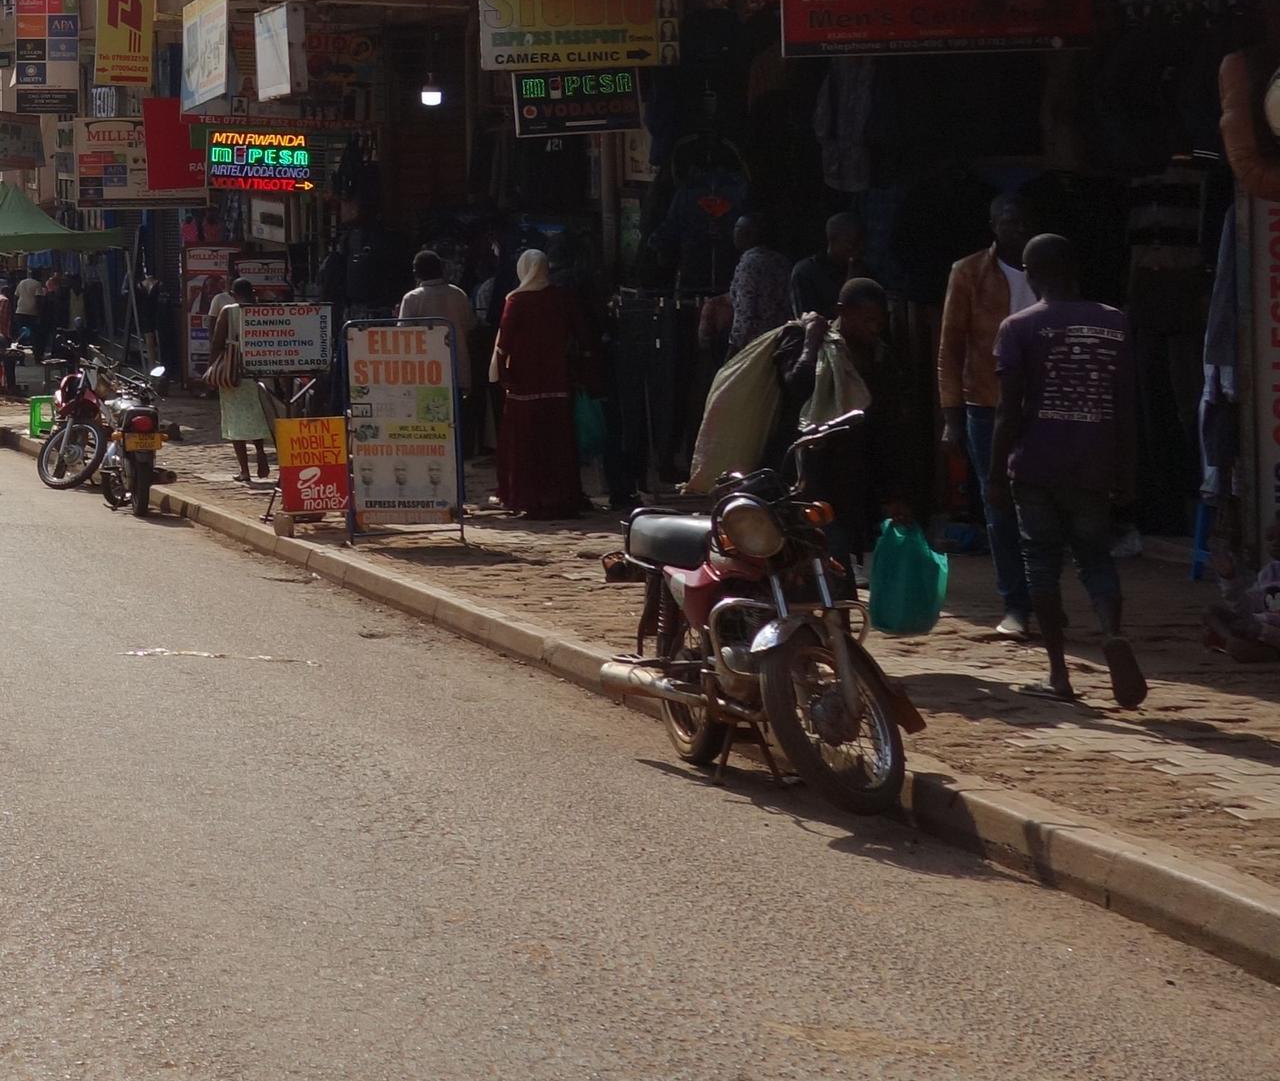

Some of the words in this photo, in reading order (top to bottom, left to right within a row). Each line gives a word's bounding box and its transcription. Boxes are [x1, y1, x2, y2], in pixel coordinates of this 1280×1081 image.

[495, 52, 561, 65] CAMERA
[567, 51, 621, 64] CLINIC
[564, 73, 633, 96] PESA
[542, 101, 637, 118] VODACOM
[213, 132, 244, 145] MTN
[245, 133, 306, 147] RWANDA
[248, 148, 309, 165] PESA
[211, 164, 275, 177] AIRTEL/VODA
[275, 166, 311, 178] CONGO
[244, 306, 286, 317] PHOTO
[289, 306, 323, 316] COPY
[244, 318, 291, 327] SCANNING
[244, 329, 295, 338] PRINTING
[319, 314, 328, 359] DESIGNING
[244, 340, 275, 348] PHOTO
[277, 339, 314, 348] EDITING
[367, 330, 427, 356] ELITE
[244, 349, 282, 357] PLASTIC
[284, 349, 300, 357] IDS
[244, 359, 296, 368] BUSSINESS
[298, 358, 328, 366] CARDS
[354, 360, 442, 386] STUDIO
[290, 434, 341, 451] MOBILE
[290, 450, 342, 466] MONEY
[355, 444, 394, 456] PHOTO
[395, 444, 445, 457] FRAMING
[300, 483, 340, 500] airtel
[303, 496, 349, 511] money
[365, 500, 395, 509] EXPRESS
[396, 500, 435, 509] PASSPORT
